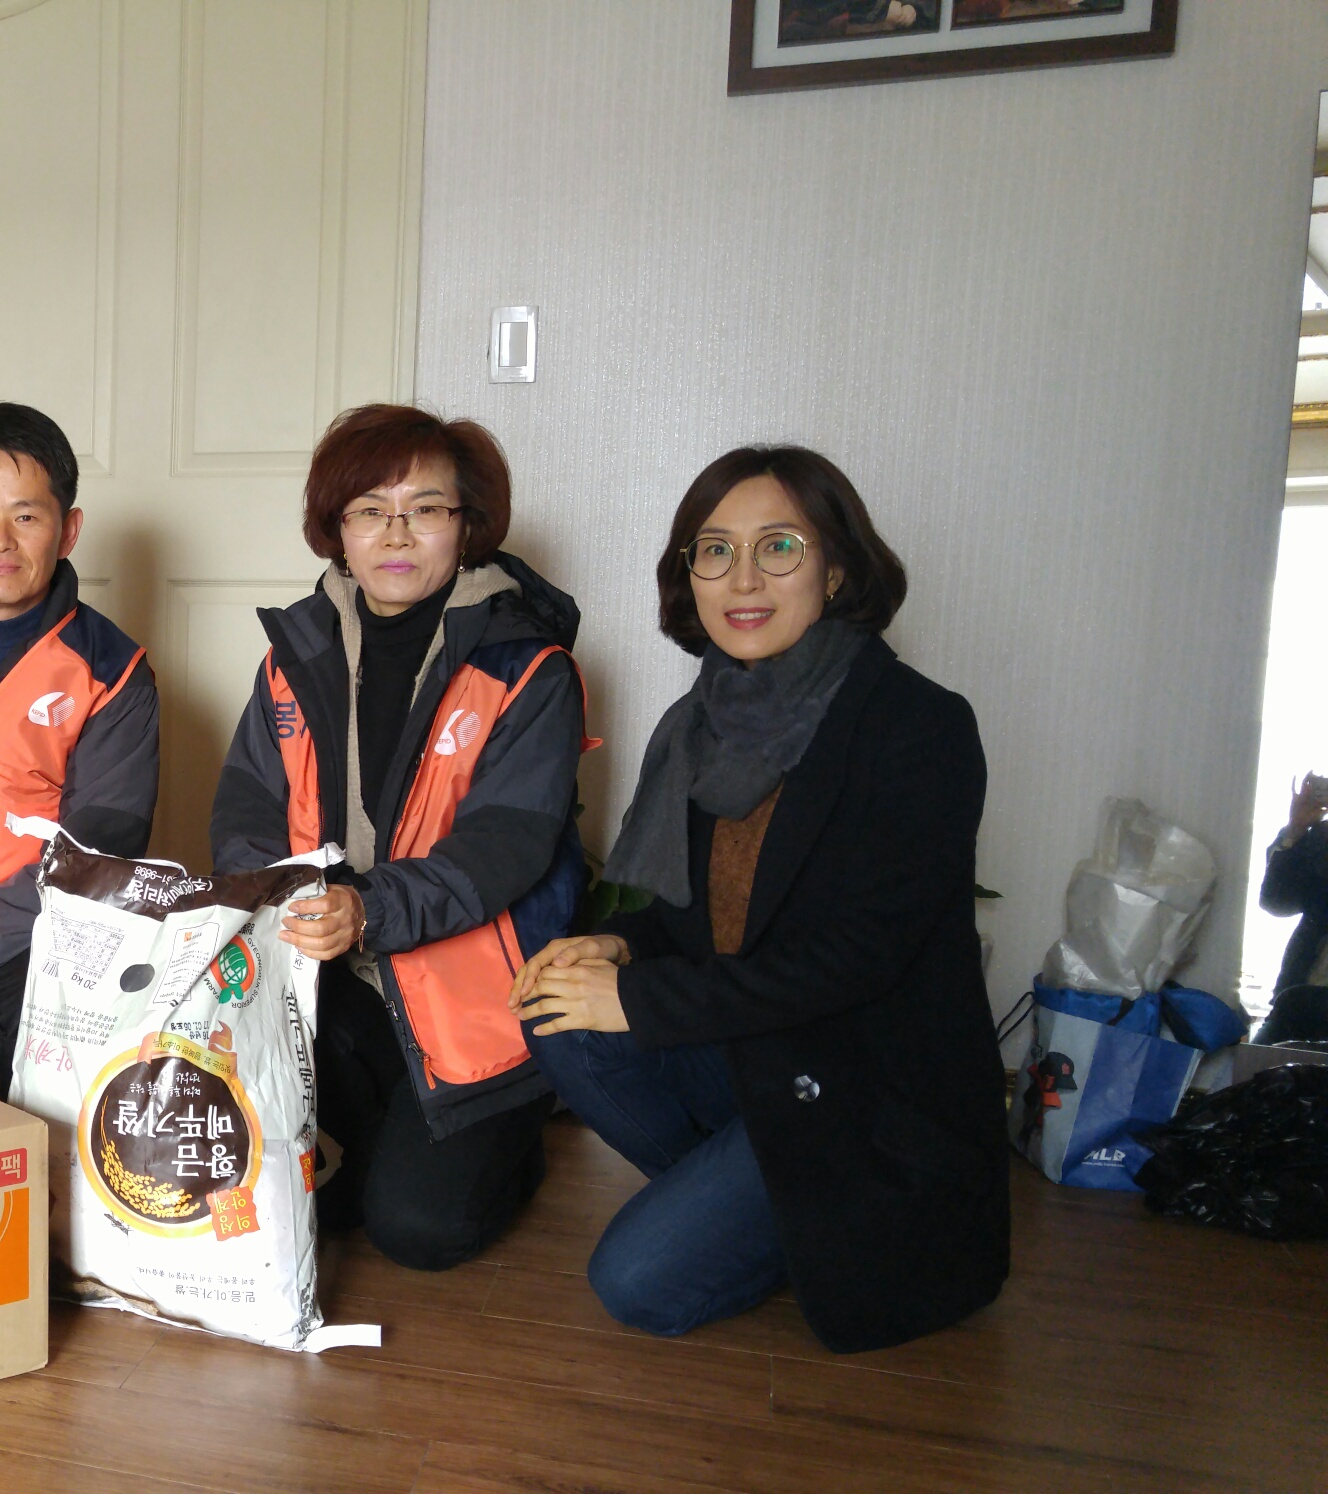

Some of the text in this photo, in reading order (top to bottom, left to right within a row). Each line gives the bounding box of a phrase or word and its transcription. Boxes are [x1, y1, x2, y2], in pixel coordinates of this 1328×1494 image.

[71, 972, 97, 991] 20 kg
[113, 1099, 234, 1140] 메뚜기쌀
[172, 1143, 238, 1179] 황금
[214, 1191, 247, 1214] 안계
[219, 1214, 251, 1235] 의성
